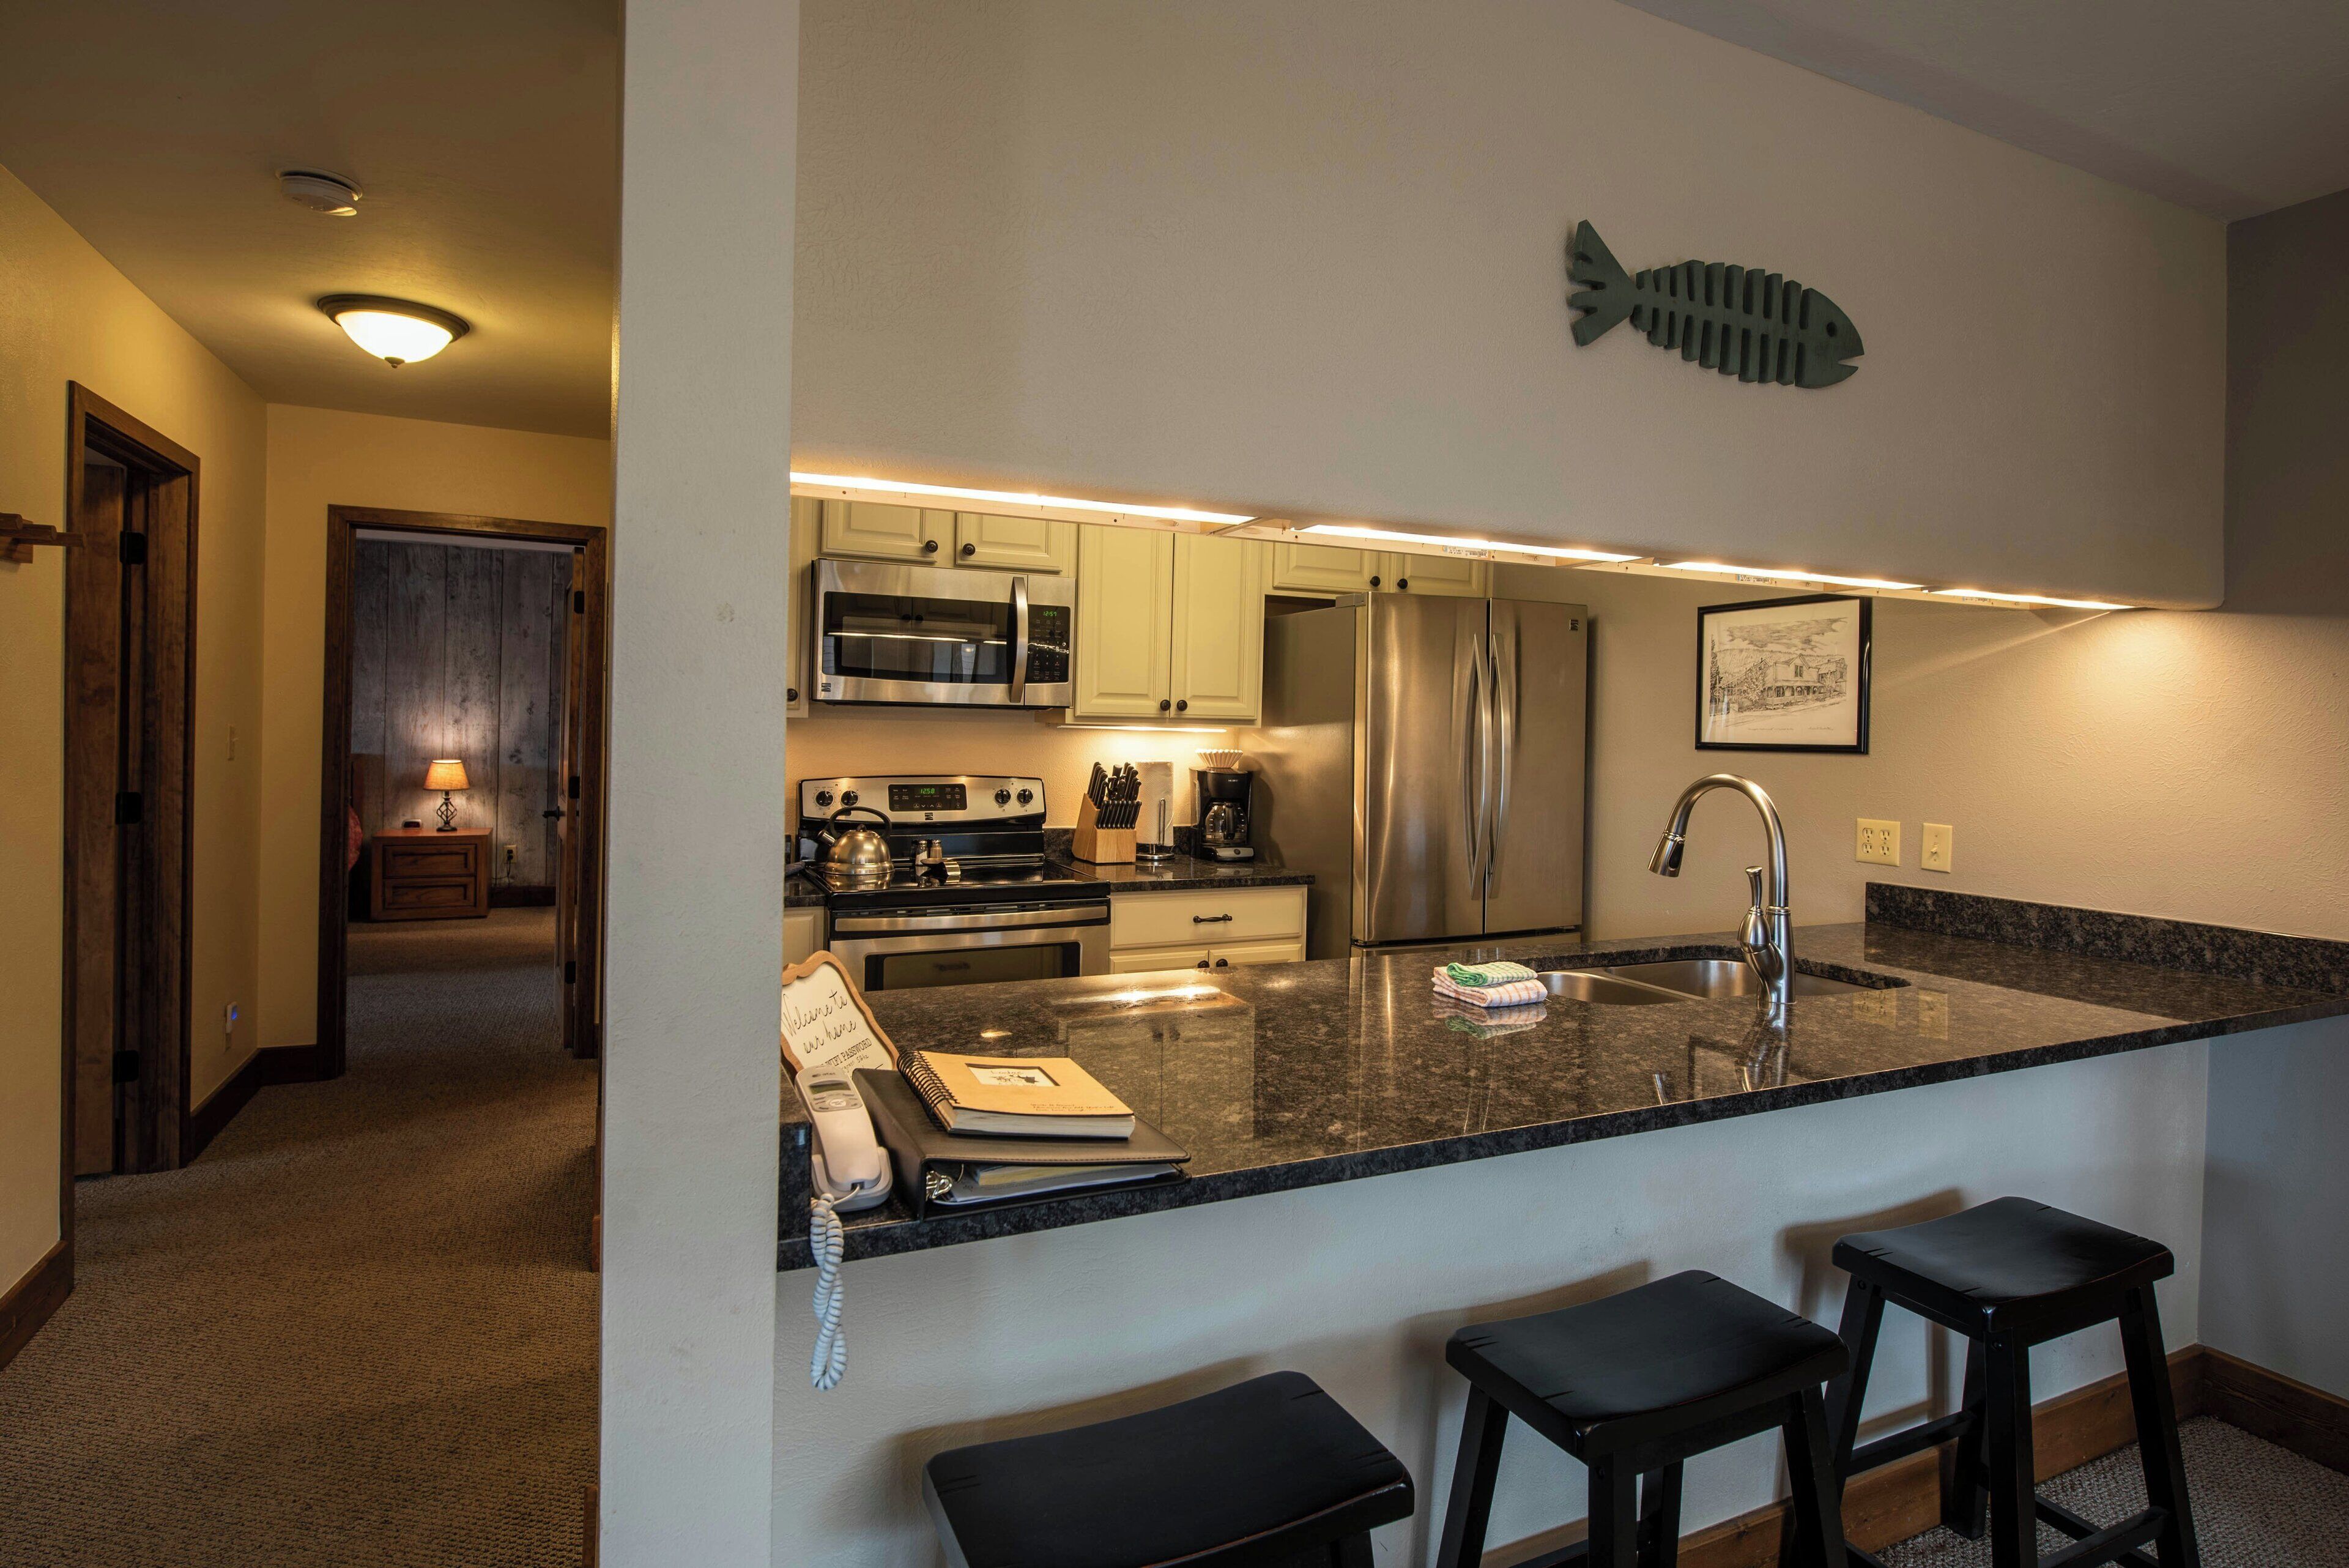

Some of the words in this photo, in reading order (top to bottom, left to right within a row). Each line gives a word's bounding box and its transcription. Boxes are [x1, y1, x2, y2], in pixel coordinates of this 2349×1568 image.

[781, 994, 833, 1037] Welcome
[829, 989, 848, 1009] to
[803, 1036, 824, 1053] our
[823, 1020, 856, 1041] home
[825, 1055, 843, 1066] WIFI
[841, 1038, 872, 1061] PASSWORD
